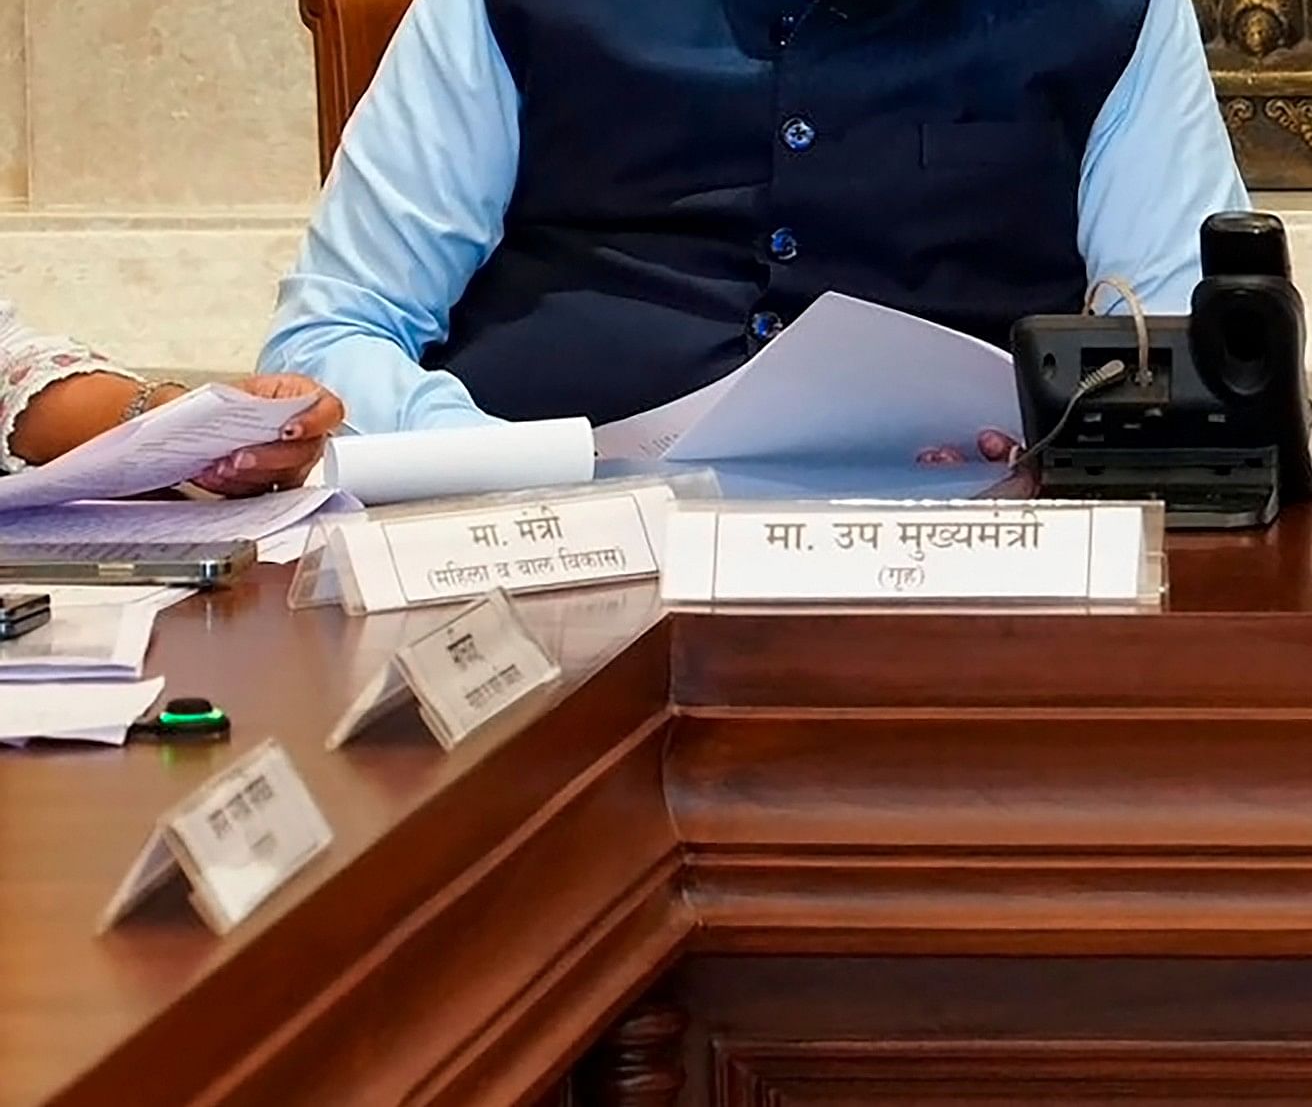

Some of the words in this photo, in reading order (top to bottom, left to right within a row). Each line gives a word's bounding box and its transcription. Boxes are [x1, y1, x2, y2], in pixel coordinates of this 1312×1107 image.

[469, 523, 509, 547] मा.
[513, 505, 564, 542] मंत्री
[764, 522, 814, 550] मा.
[833, 521, 880, 549] उप
[898, 509, 1044, 561] मुख्यमंत्री
[427, 560, 489, 591] (महिला
[558, 546, 627, 571] विकास)
[877, 565, 926, 591] (गृह)
